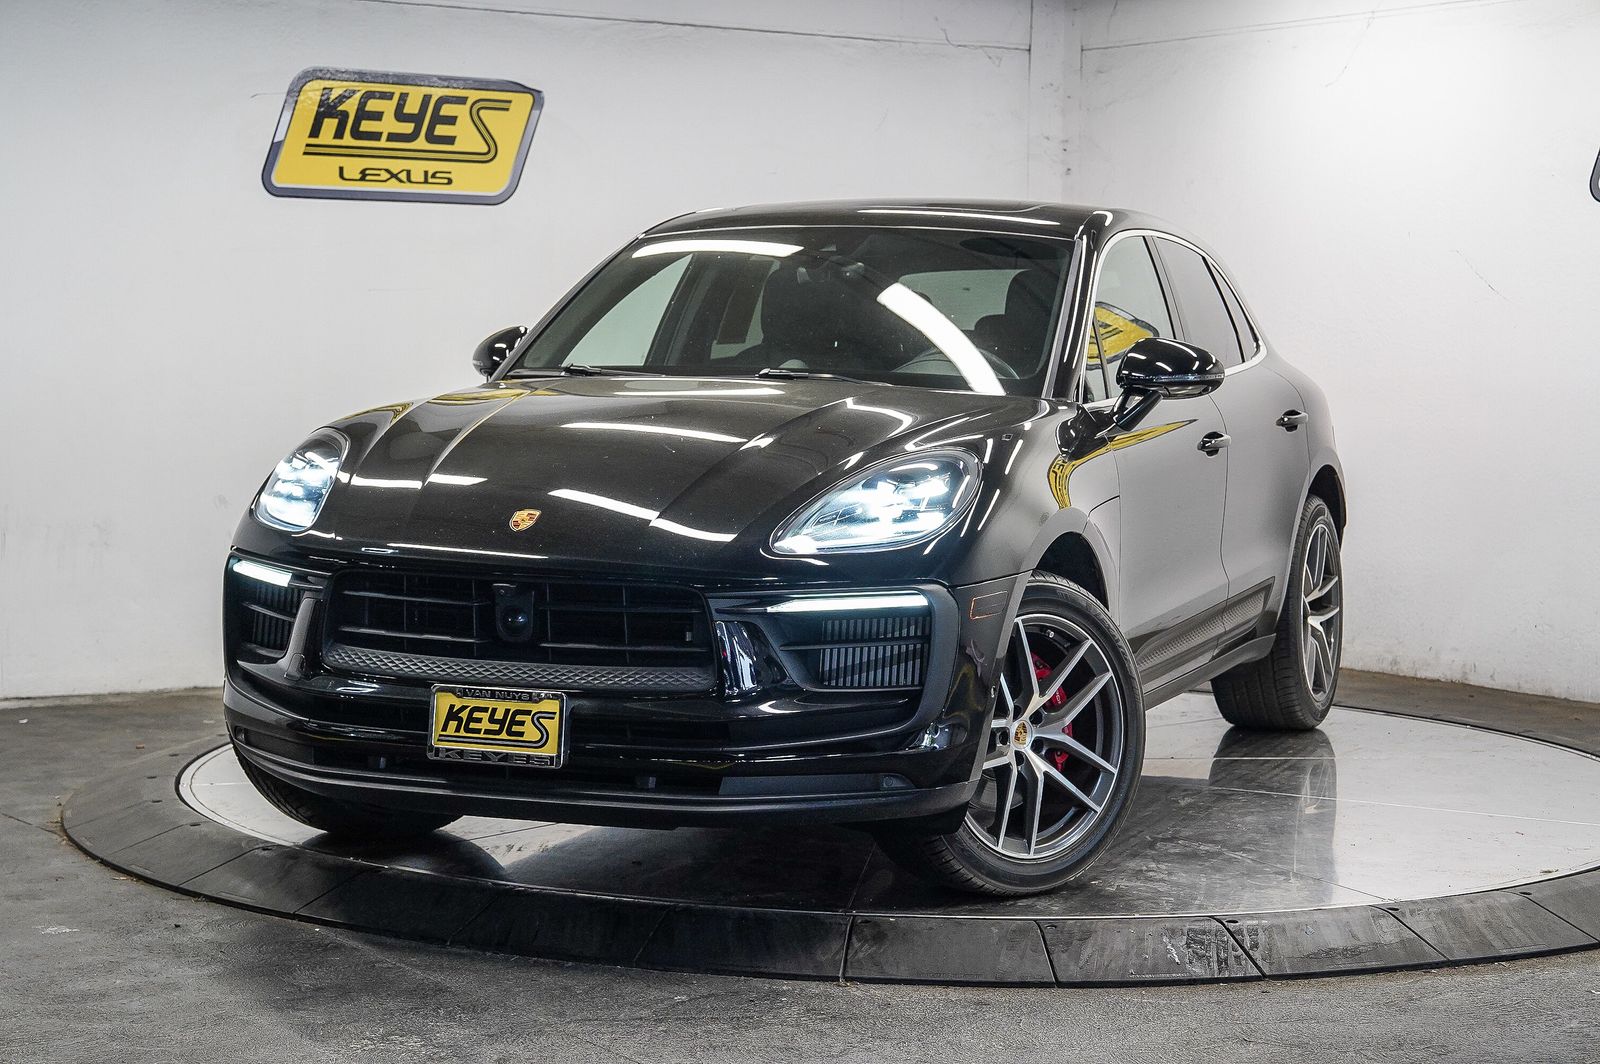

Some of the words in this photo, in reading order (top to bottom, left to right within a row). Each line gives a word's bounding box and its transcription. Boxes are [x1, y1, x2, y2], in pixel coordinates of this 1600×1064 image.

[304, 87, 513, 163] KEYES
[338, 166, 453, 185] LEXUS
[466, 689, 491, 698] VAN
[495, 690, 530, 700] NUYS
[438, 704, 557, 749] KEYES
[438, 749, 551, 765] KEYES
